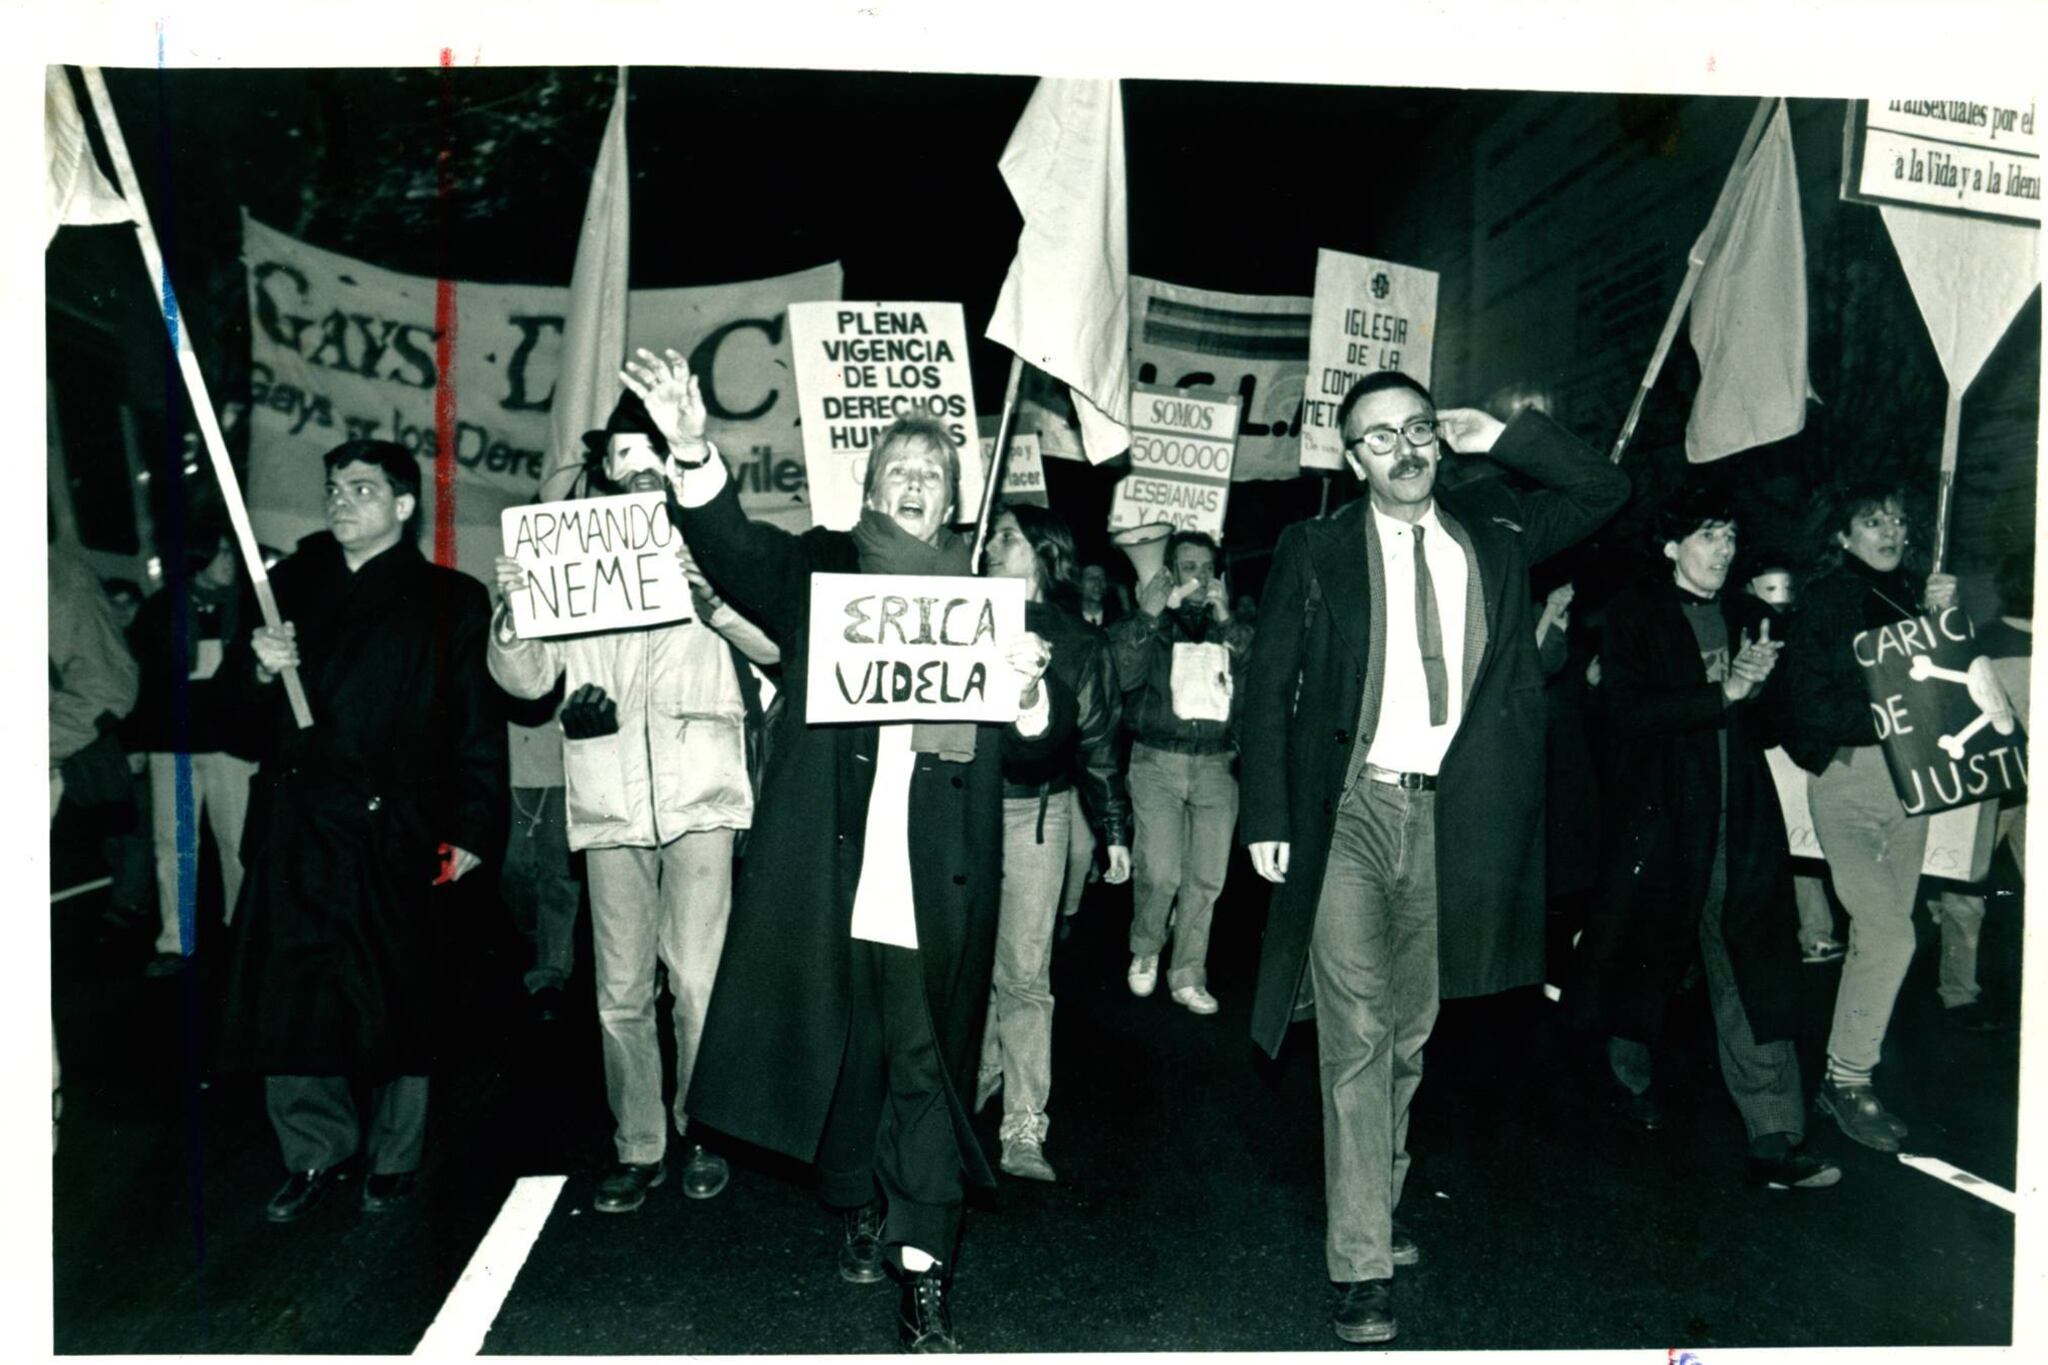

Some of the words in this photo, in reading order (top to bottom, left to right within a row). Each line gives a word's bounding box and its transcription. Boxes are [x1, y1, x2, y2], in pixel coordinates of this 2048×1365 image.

[1990, 106, 2018, 139] por
[2021, 102, 2035, 135] el
[1894, 155, 1904, 179] a
[1908, 148, 1924, 182] la
[1927, 150, 1958, 188] Vida
[1958, 167, 1971, 199] y
[1972, 168, 1982, 191] a
[1986, 160, 2001, 194] la
[254, 261, 445, 389] GAYS
[687, 313, 785, 421] C
[837, 311, 928, 335] PLENA
[1344, 308, 1408, 345] IGLESIA
[822, 339, 955, 363] VIGENCIA
[1346, 343, 1369, 367] DE
[844, 365, 878, 389] DE
[886, 364, 942, 389] LOS
[1150, 400, 1215, 431] SOMOS
[1123, 479, 1219, 513] LESBIANAS
[504, 502, 673, 560] ARMANDO
[1138, 507, 1154, 531] Y
[527, 553, 662, 620] NEME
[843, 595, 996, 647] ERICA
[835, 660, 987, 705] VIDELA
[1870, 694, 1914, 740] DE
